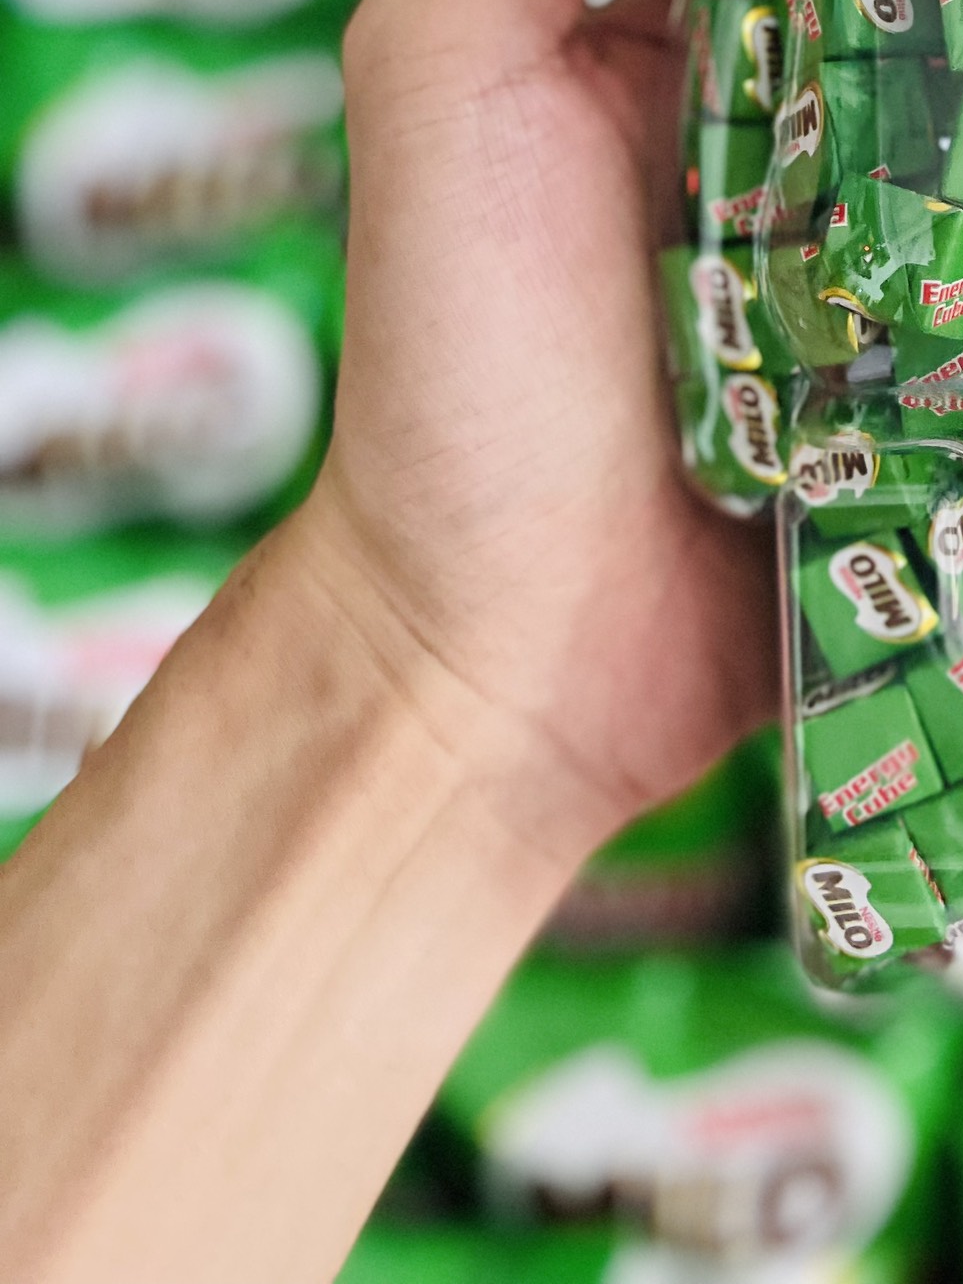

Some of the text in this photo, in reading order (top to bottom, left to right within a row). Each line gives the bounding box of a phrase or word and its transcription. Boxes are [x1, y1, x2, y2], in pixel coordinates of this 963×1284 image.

[740, 384, 774, 469] MILO
[850, 554, 912, 630] MILO
[818, 739, 921, 819] Energy
[842, 772, 919, 827] Cube
[812, 870, 873, 949] MILO
